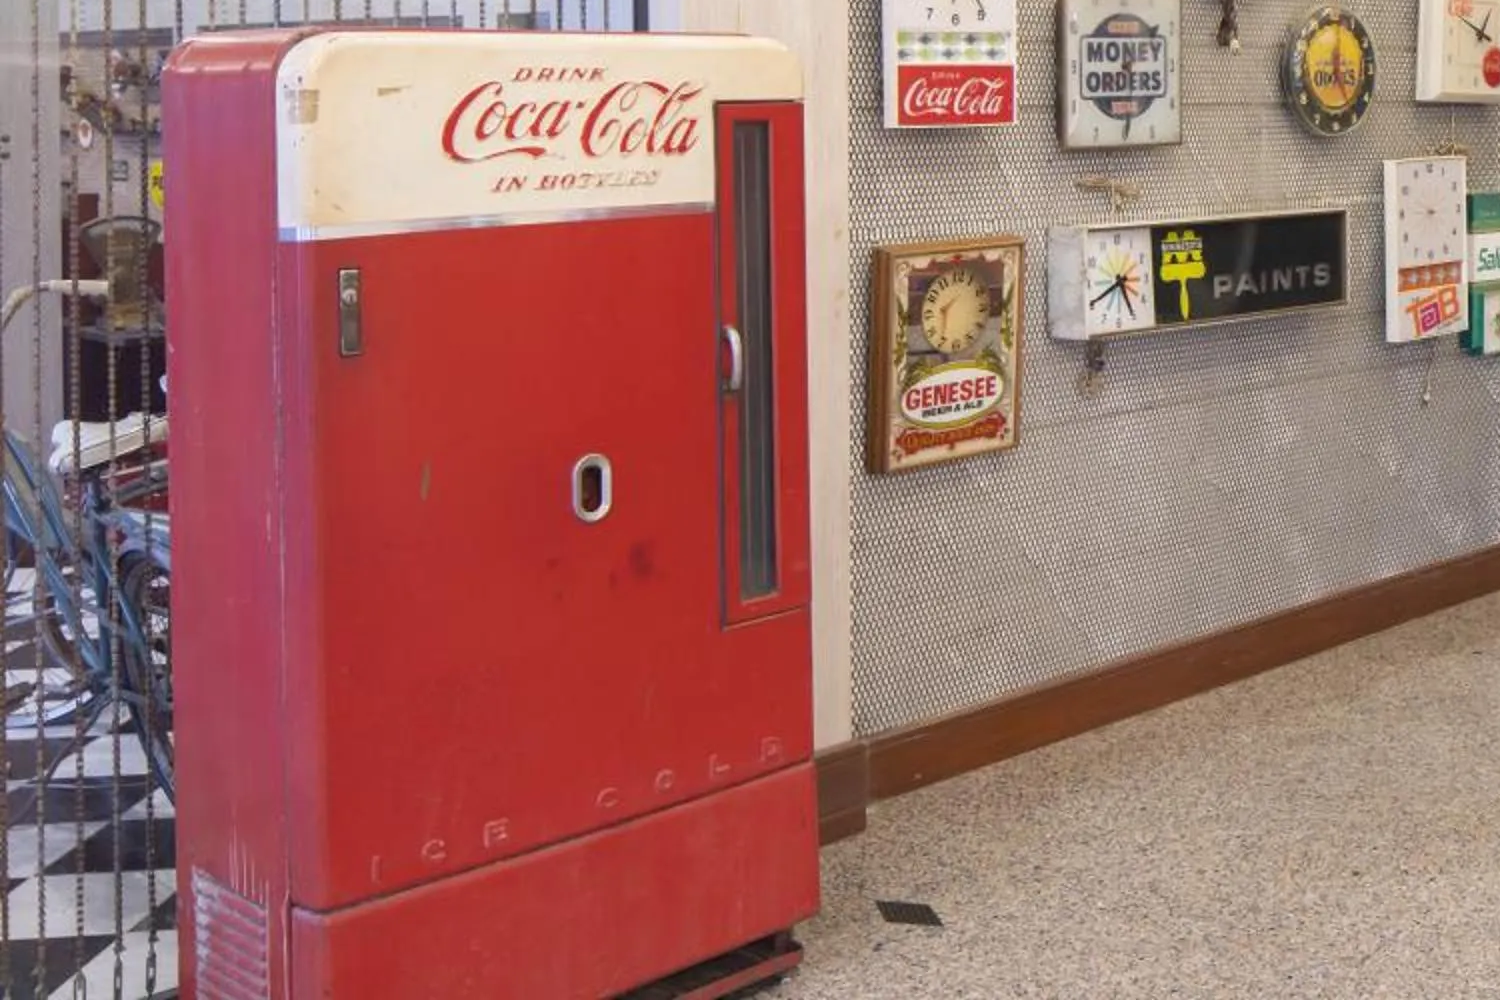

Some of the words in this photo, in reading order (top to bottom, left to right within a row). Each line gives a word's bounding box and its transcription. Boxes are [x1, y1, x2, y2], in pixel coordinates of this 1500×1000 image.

[1086, 40, 1163, 63] MONEY
[512, 66, 608, 83] DRINK
[1086, 70, 1163, 93] ORDERS
[903, 77, 1006, 117] Coca-Cola
[441, 80, 709, 164] Coca-Cola
[490, 174, 528, 193] IN
[533, 169, 661, 191] BOTTLES
[1213, 262, 1332, 299] PAINTS
[905, 375, 998, 411] GENESEE
